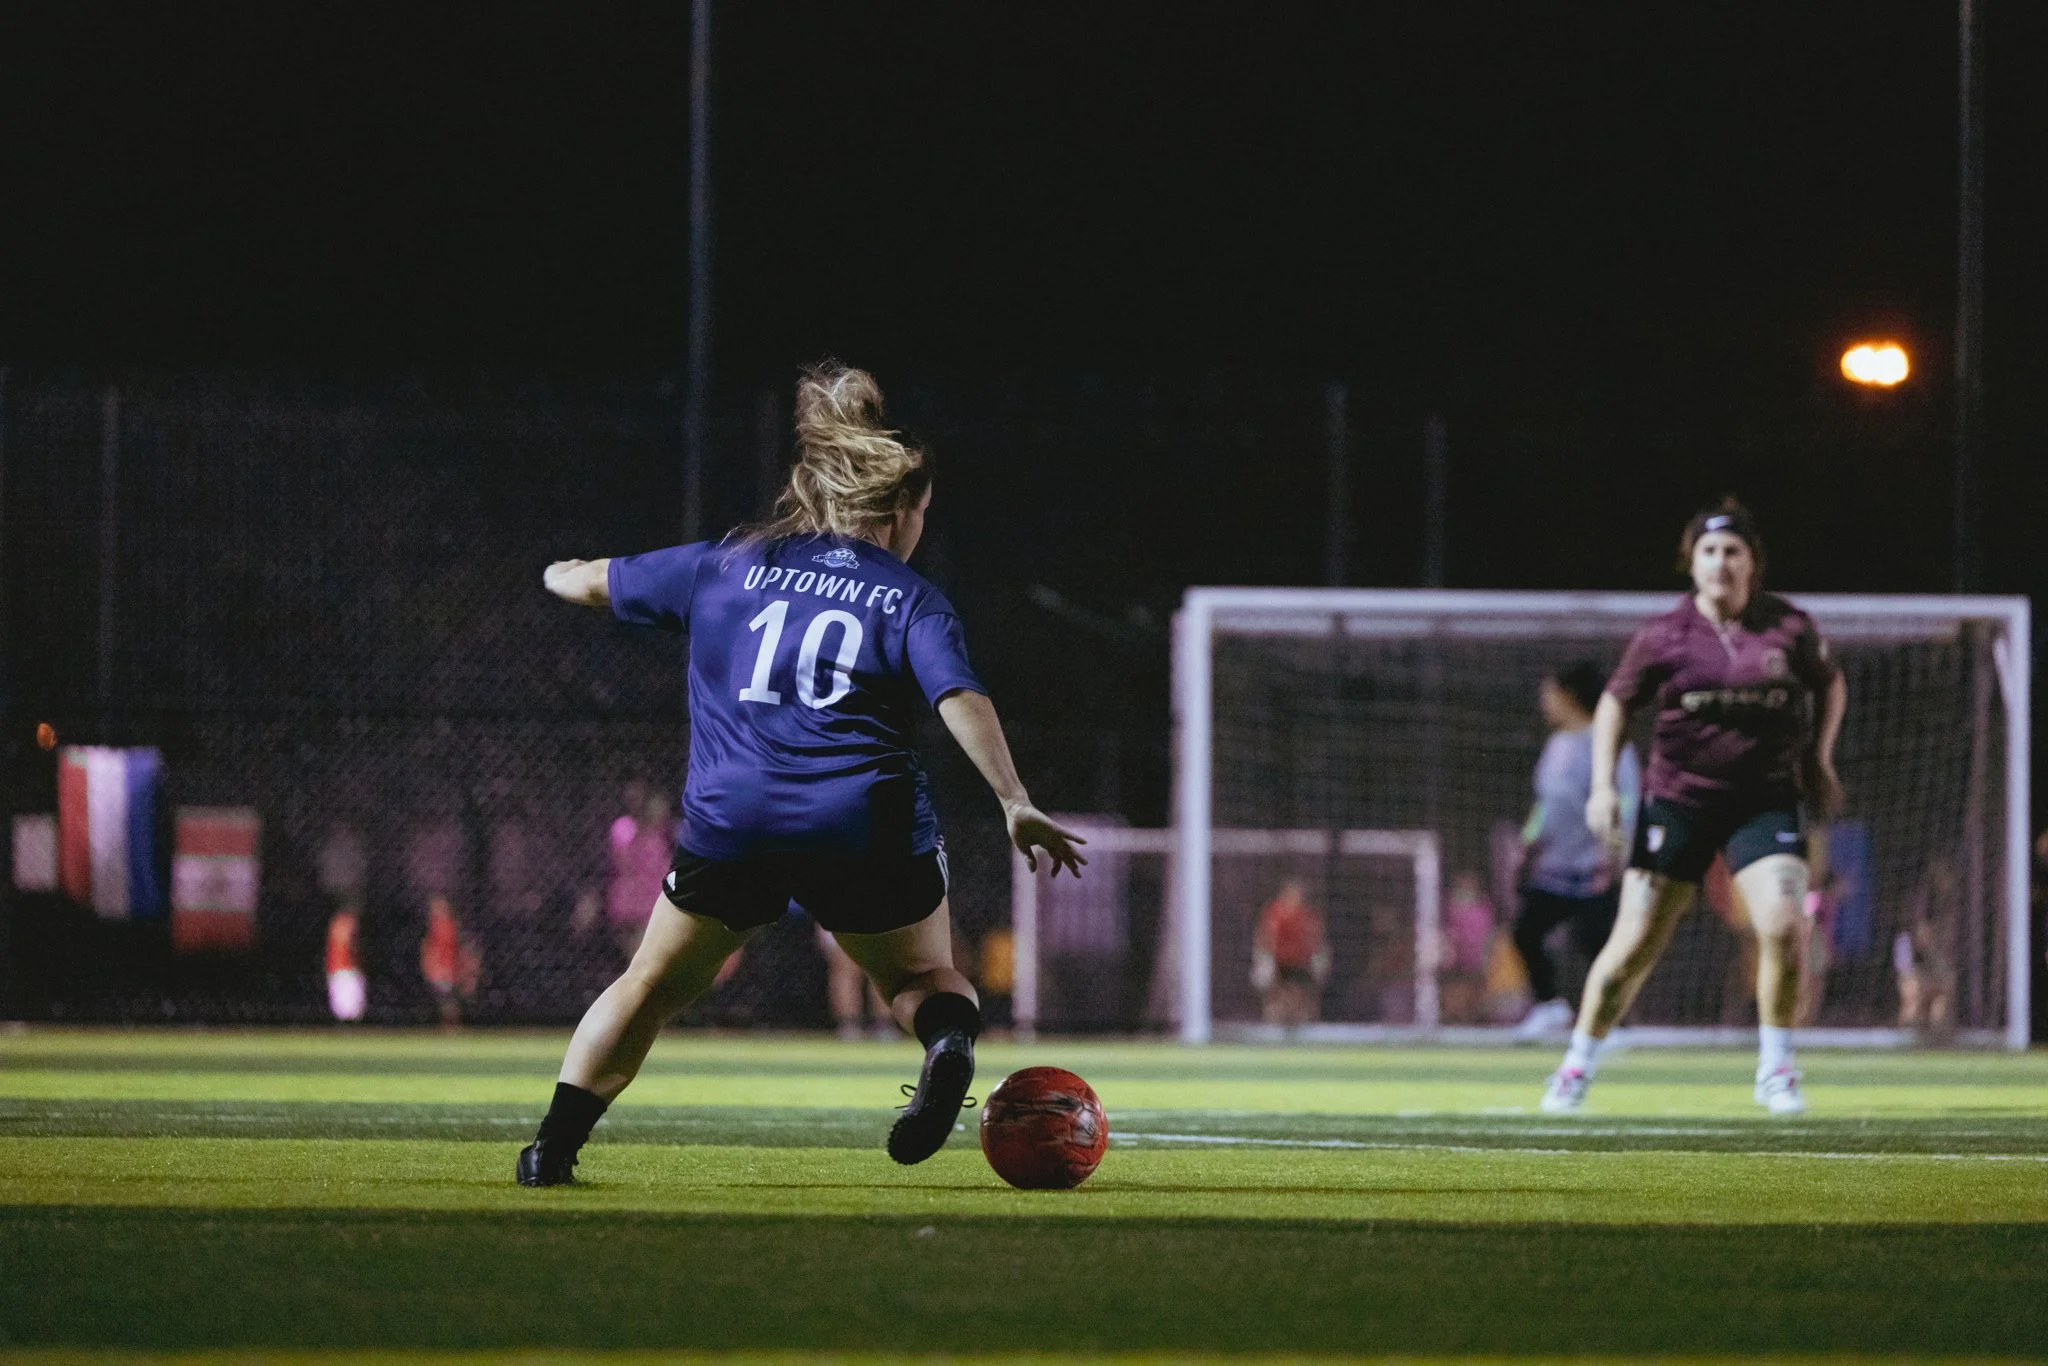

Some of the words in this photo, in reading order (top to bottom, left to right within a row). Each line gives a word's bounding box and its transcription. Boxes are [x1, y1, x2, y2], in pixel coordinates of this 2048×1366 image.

[743, 565, 865, 603] UPTOWN
[865, 585, 903, 615] FC
[738, 600, 864, 710] 10
